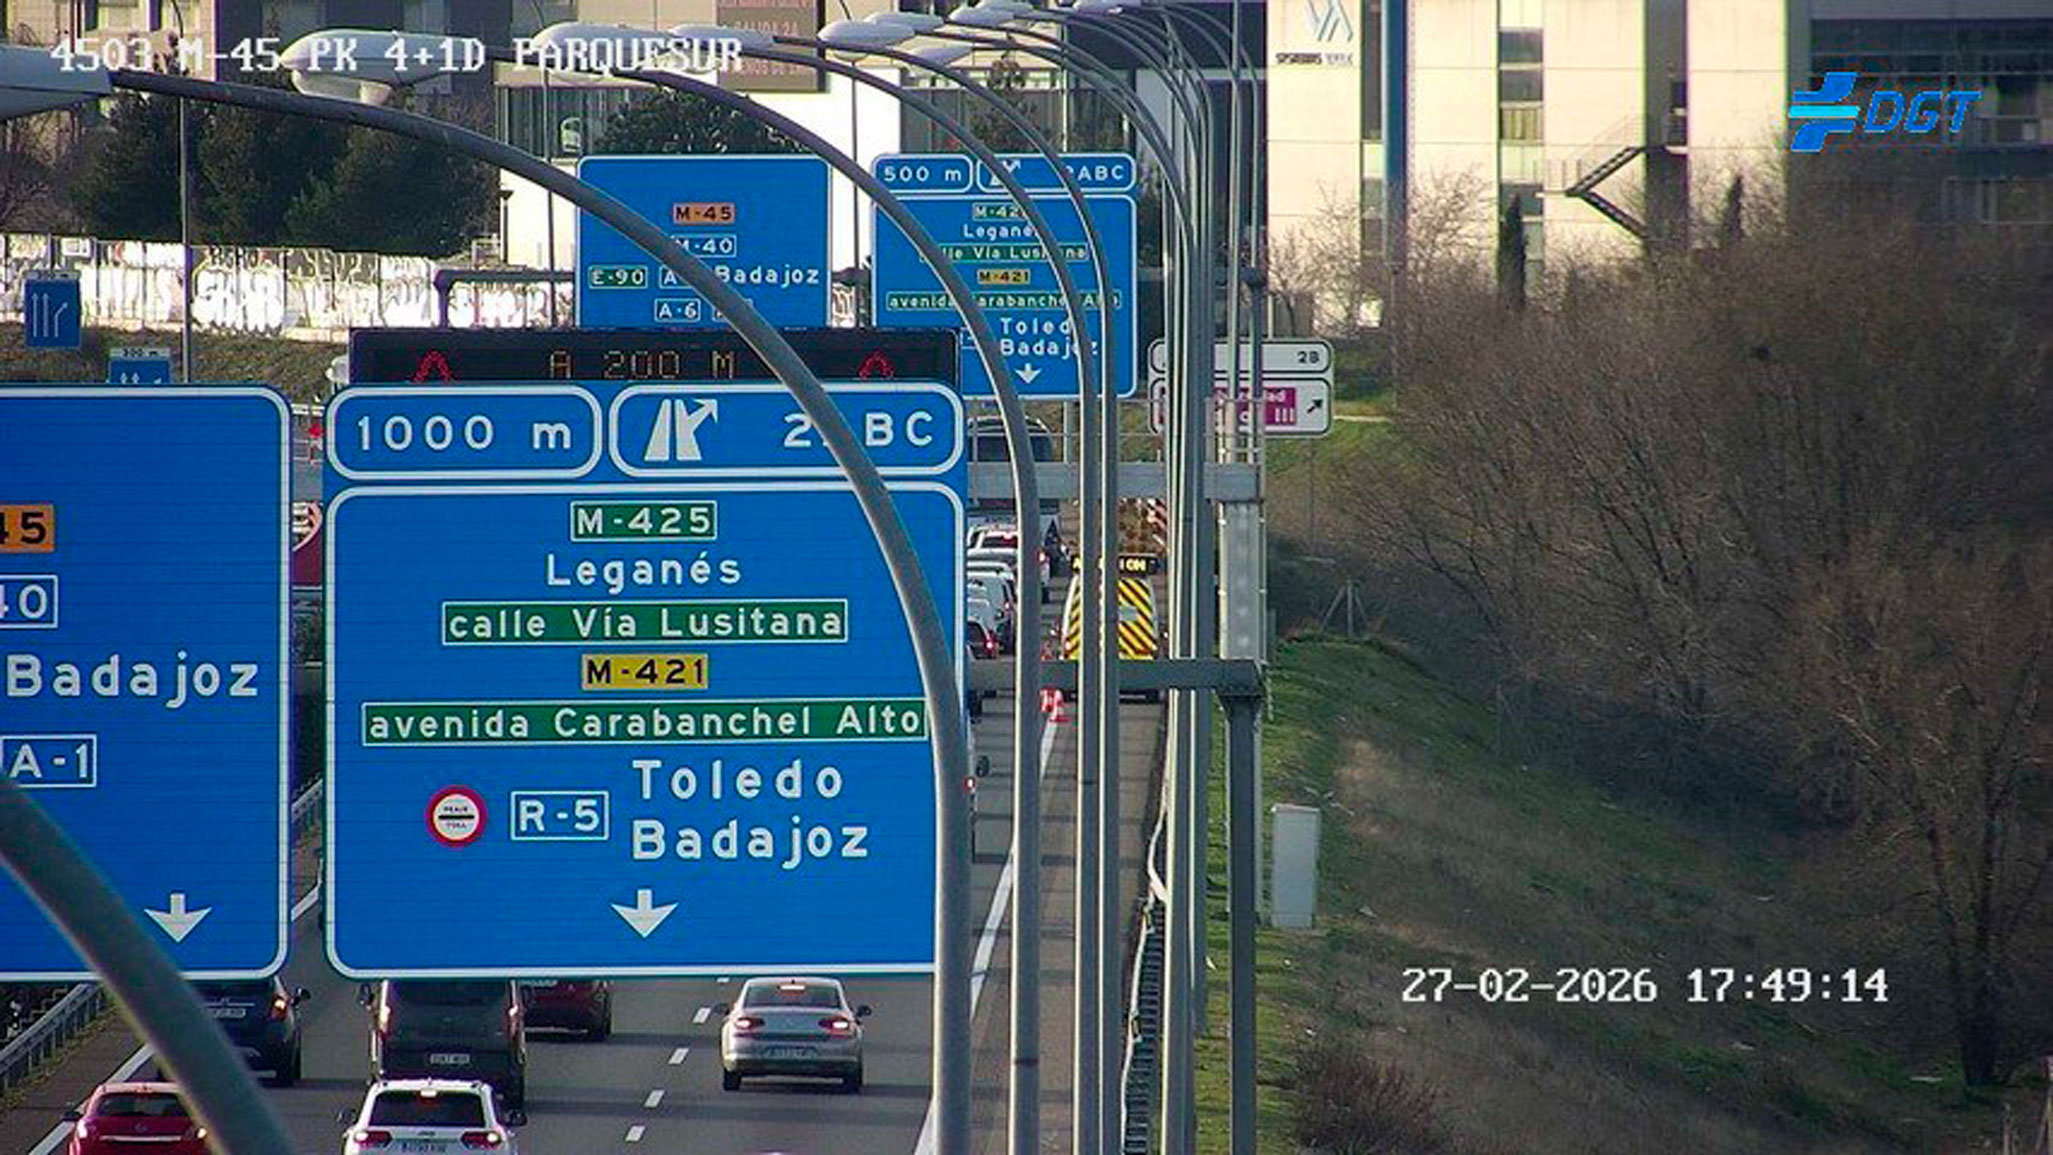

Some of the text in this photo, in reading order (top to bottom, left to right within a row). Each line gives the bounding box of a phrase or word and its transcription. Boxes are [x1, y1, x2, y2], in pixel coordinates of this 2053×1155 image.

[884, 165, 962, 182] 500 m
[676, 206, 733, 221] M-45
[976, 205, 1024, 217] M-42
[590, 269, 645, 285] E-90
[714, 264, 820, 288] Badajoz
[979, 271, 1029, 283] M-421
[658, 301, 698, 319] A-6
[1000, 317, 1071, 335] Toled
[550, 350, 735, 379] A 200 M
[356, 415, 573, 451] 1000 m
[784, 410, 933, 447] 2BC
[577, 506, 712, 536] M-425
[546, 552, 742, 595] Leganés
[449, 605, 842, 639] calle Vía Lusitana
[6, 650, 259, 709] Badajoz
[586, 656, 704, 685] M-421
[369, 703, 921, 740] avenida Carabanchel Alto
[9, 742, 88, 779] A-1
[633, 758, 843, 801] Toledo
[519, 799, 601, 832] R-5
[632, 815, 869, 870] Badajoz
